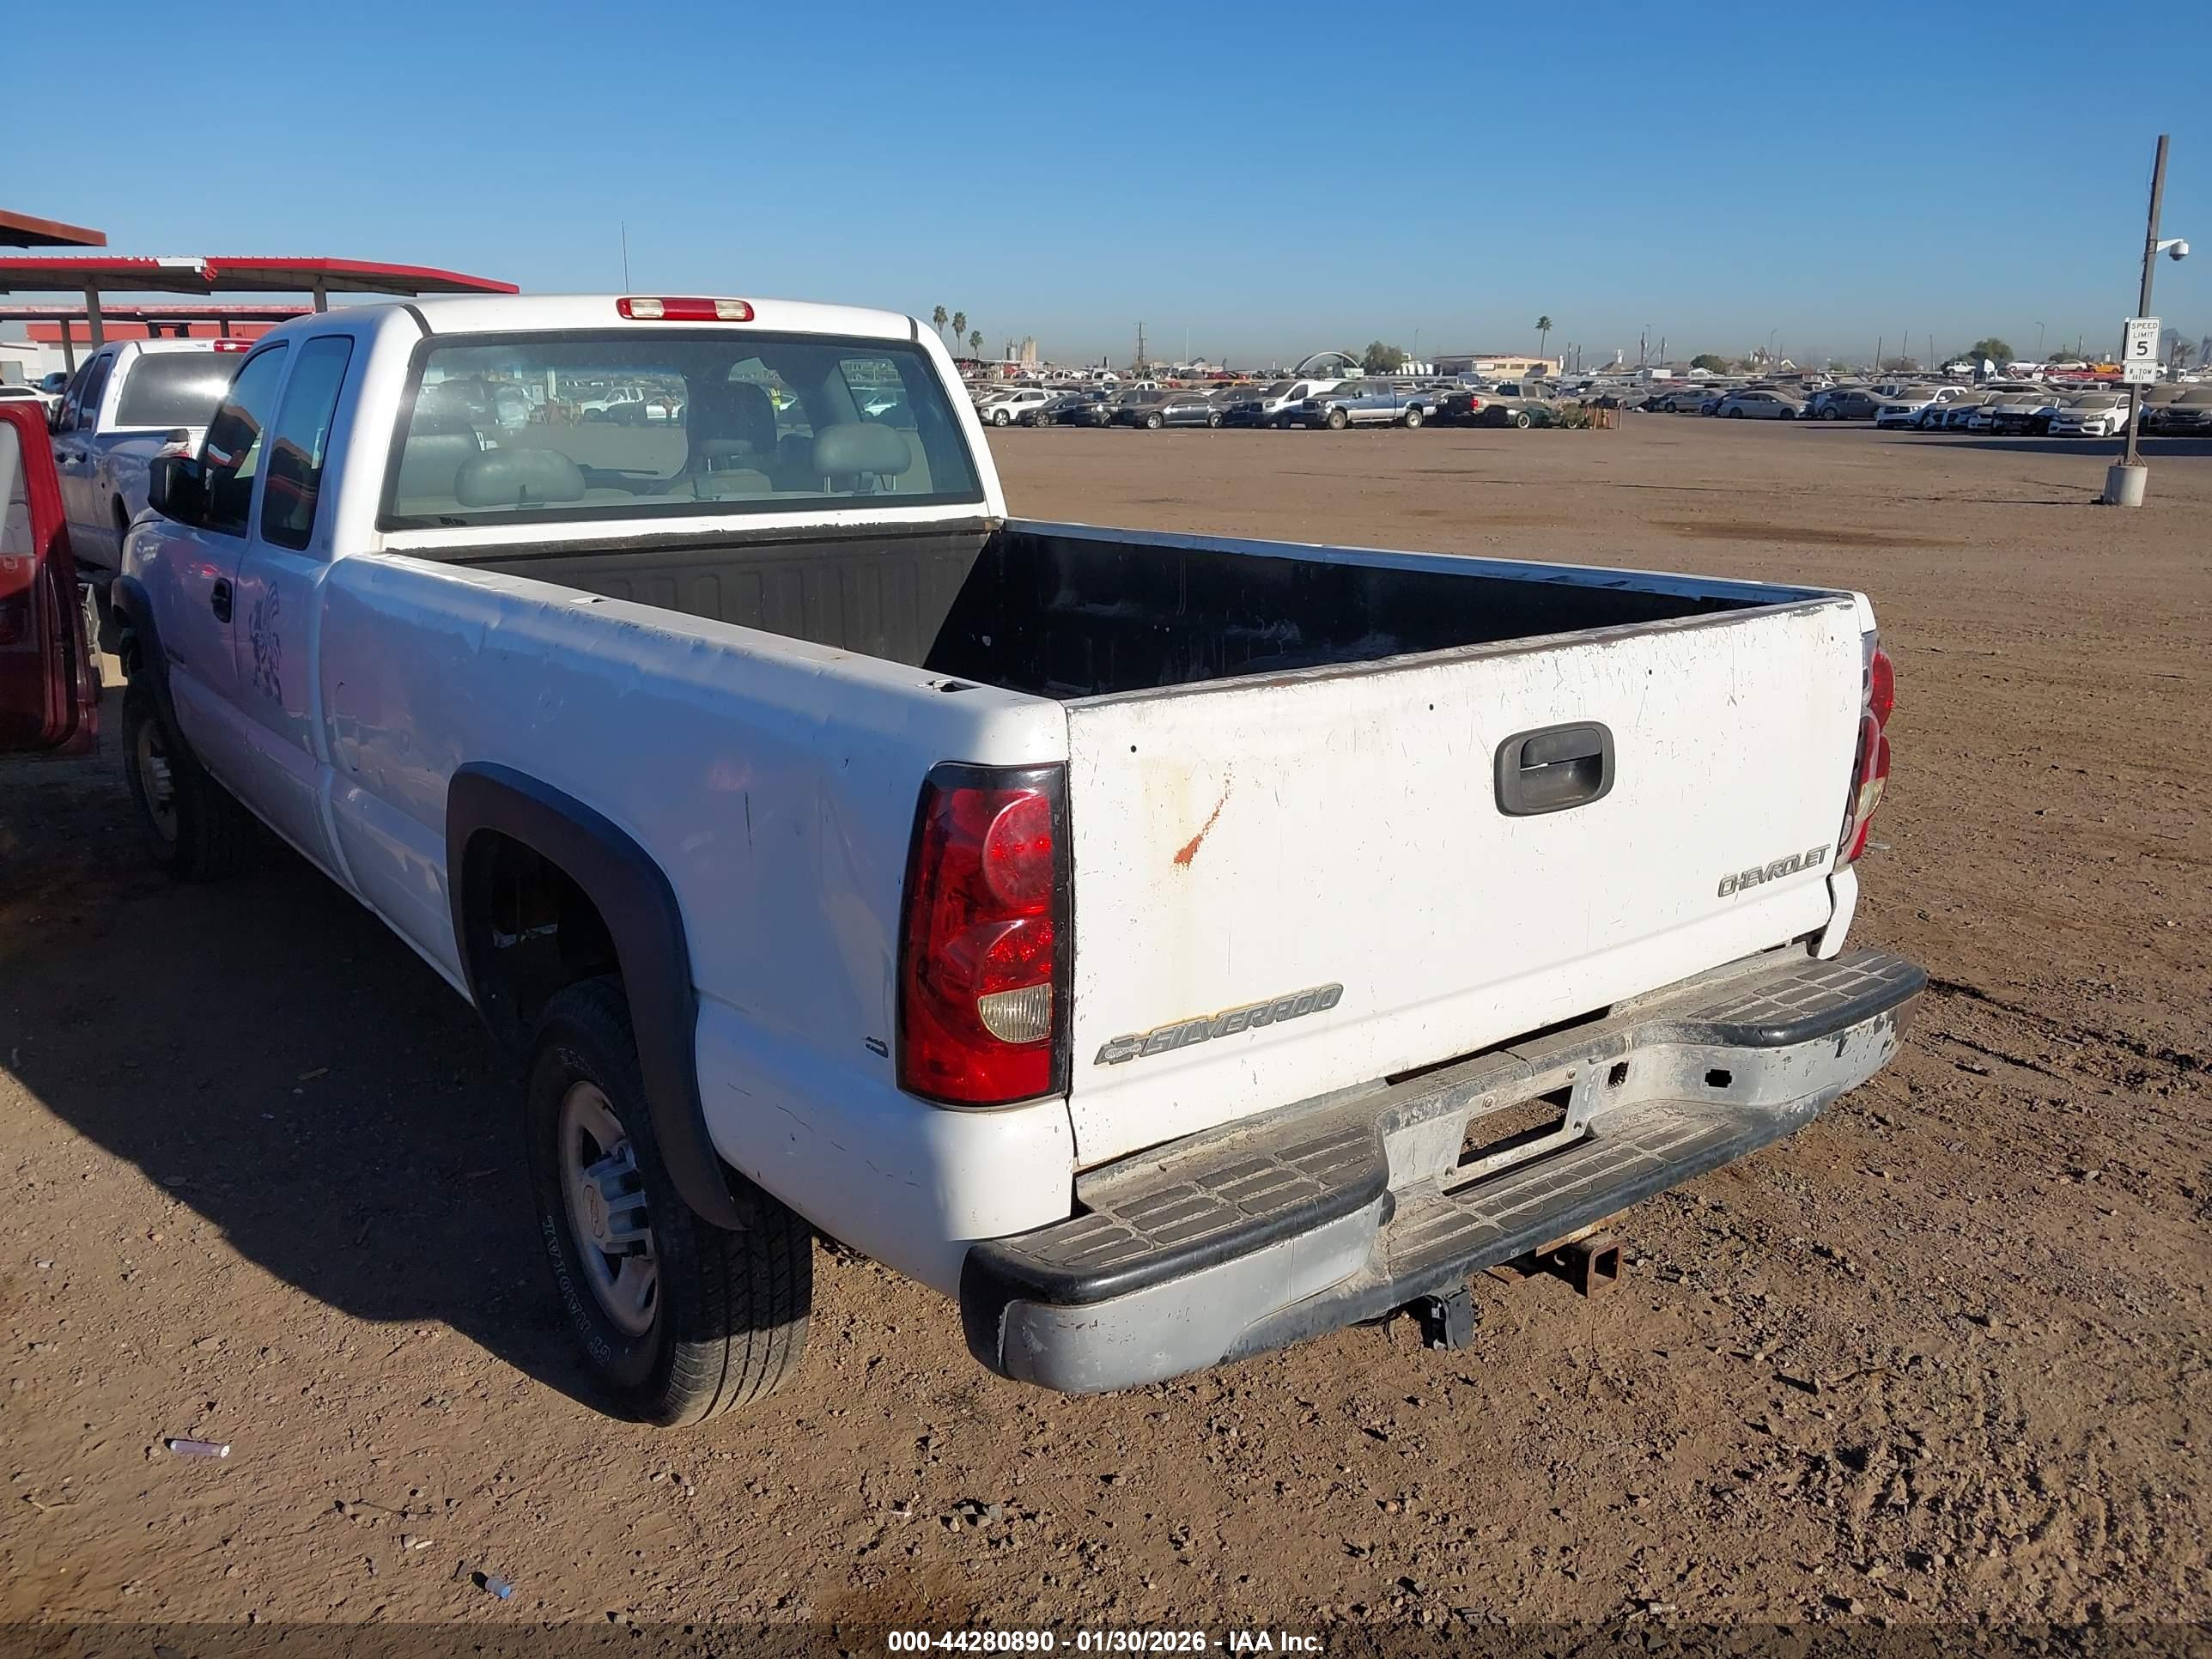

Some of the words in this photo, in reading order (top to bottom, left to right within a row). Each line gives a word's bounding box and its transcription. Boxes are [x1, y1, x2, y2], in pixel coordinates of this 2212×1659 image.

[2136, 341, 2148, 356] 5
[1717, 844, 1831, 898] CHEVROLET
[1139, 981, 1345, 1058] SILVERADO
[542, 1214, 591, 1334] RADIAL
